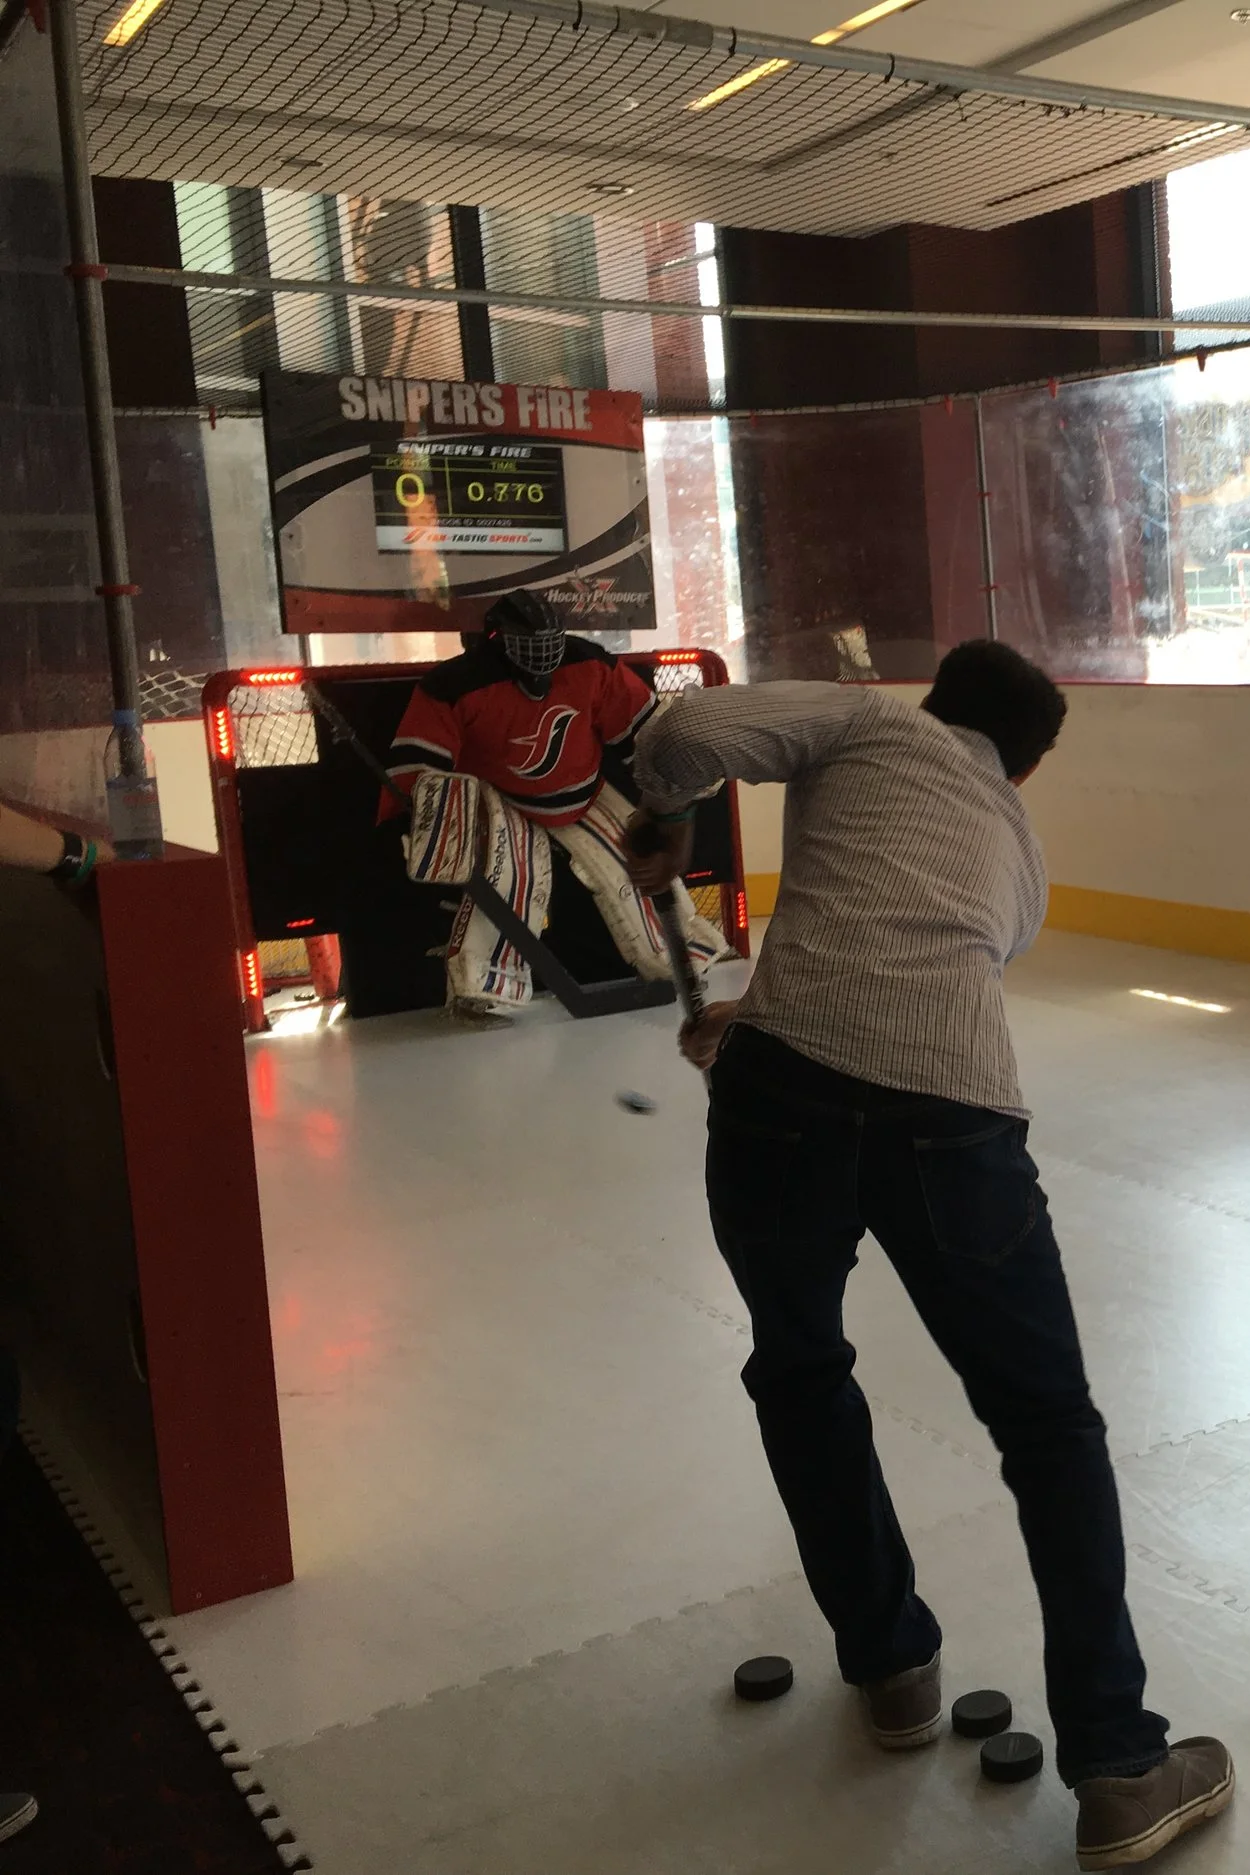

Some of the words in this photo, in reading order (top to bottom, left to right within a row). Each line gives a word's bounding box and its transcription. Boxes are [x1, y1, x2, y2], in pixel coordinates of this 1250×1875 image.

[338, 376, 505, 426] SNIPER'S
[397, 443, 485, 457] SNIPER'S
[489, 446, 533, 458] FIRE
[395, 473, 425, 508] 0
[487, 827, 507, 888] Reebok
